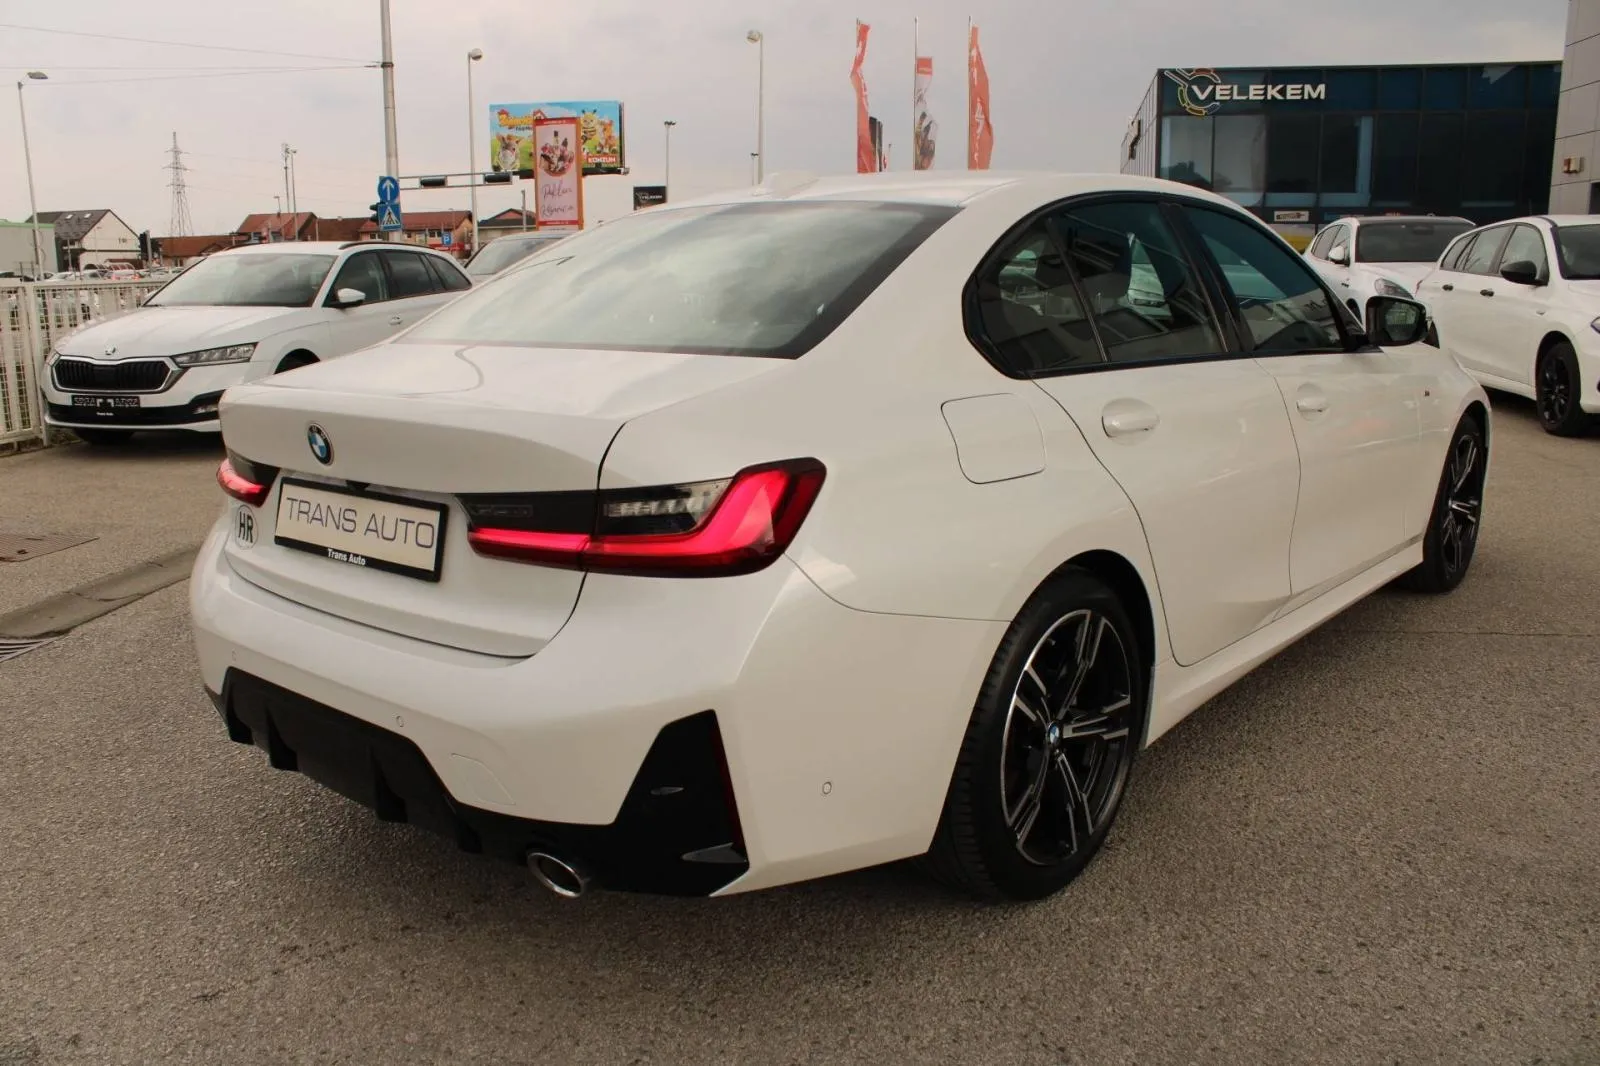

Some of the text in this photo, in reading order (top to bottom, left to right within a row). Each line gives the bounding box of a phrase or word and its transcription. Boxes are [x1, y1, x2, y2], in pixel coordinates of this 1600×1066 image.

[1191, 83, 1326, 100] VELEKEM
[239, 510, 254, 544] HR
[286, 496, 435, 549] TRANS AUTO
[327, 548, 366, 567] Trans Auto
